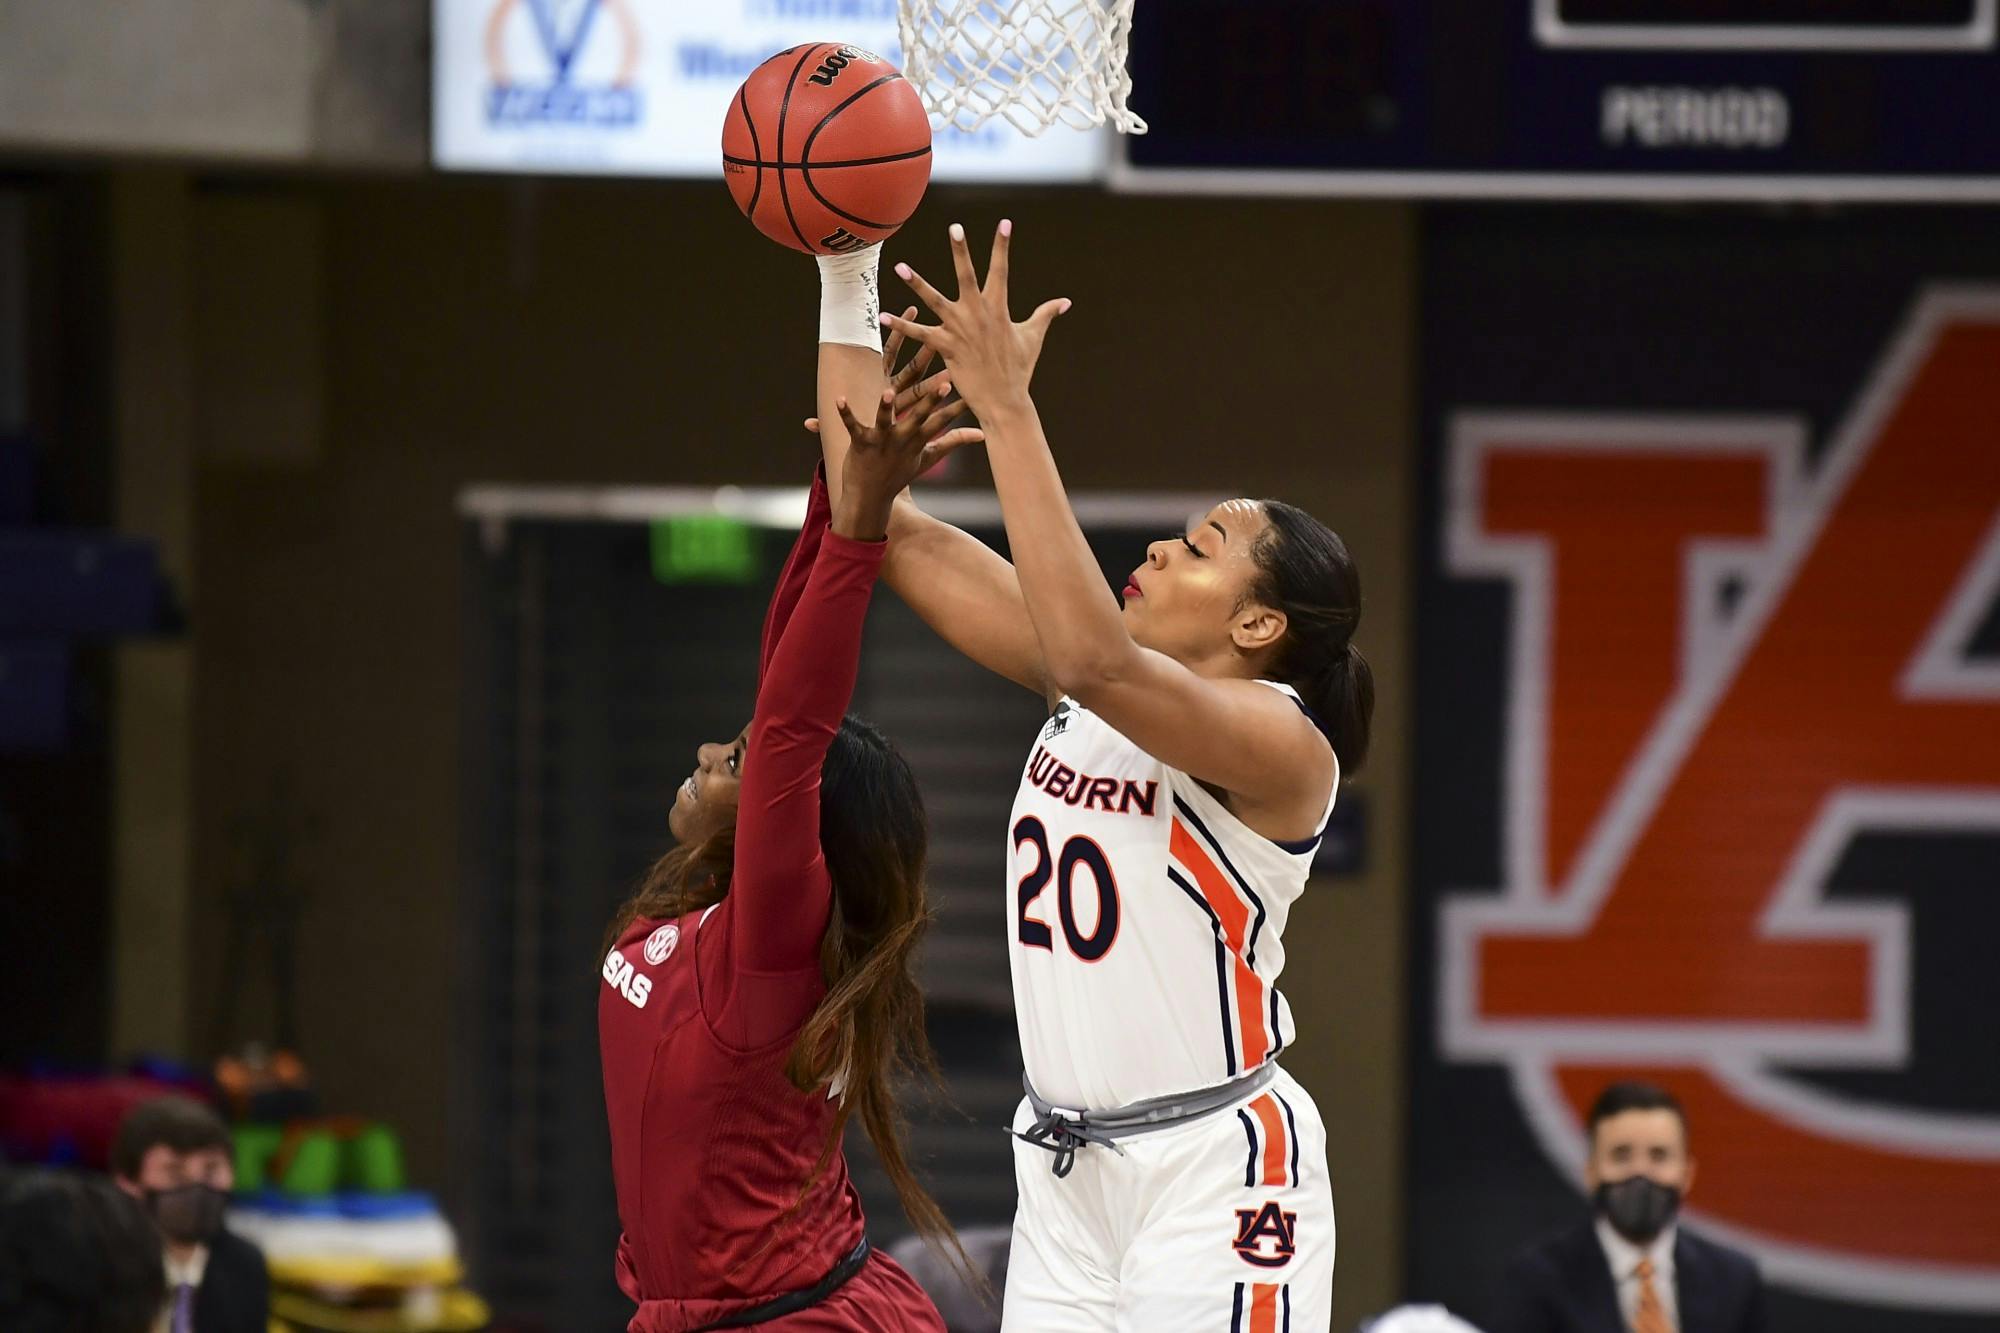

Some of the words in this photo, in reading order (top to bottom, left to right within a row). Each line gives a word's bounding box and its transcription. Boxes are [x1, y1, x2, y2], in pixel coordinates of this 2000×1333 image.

[1602, 86, 1790, 147] PERIOD
[1012, 814, 1120, 963] 20
[602, 944, 652, 1009] SAS
